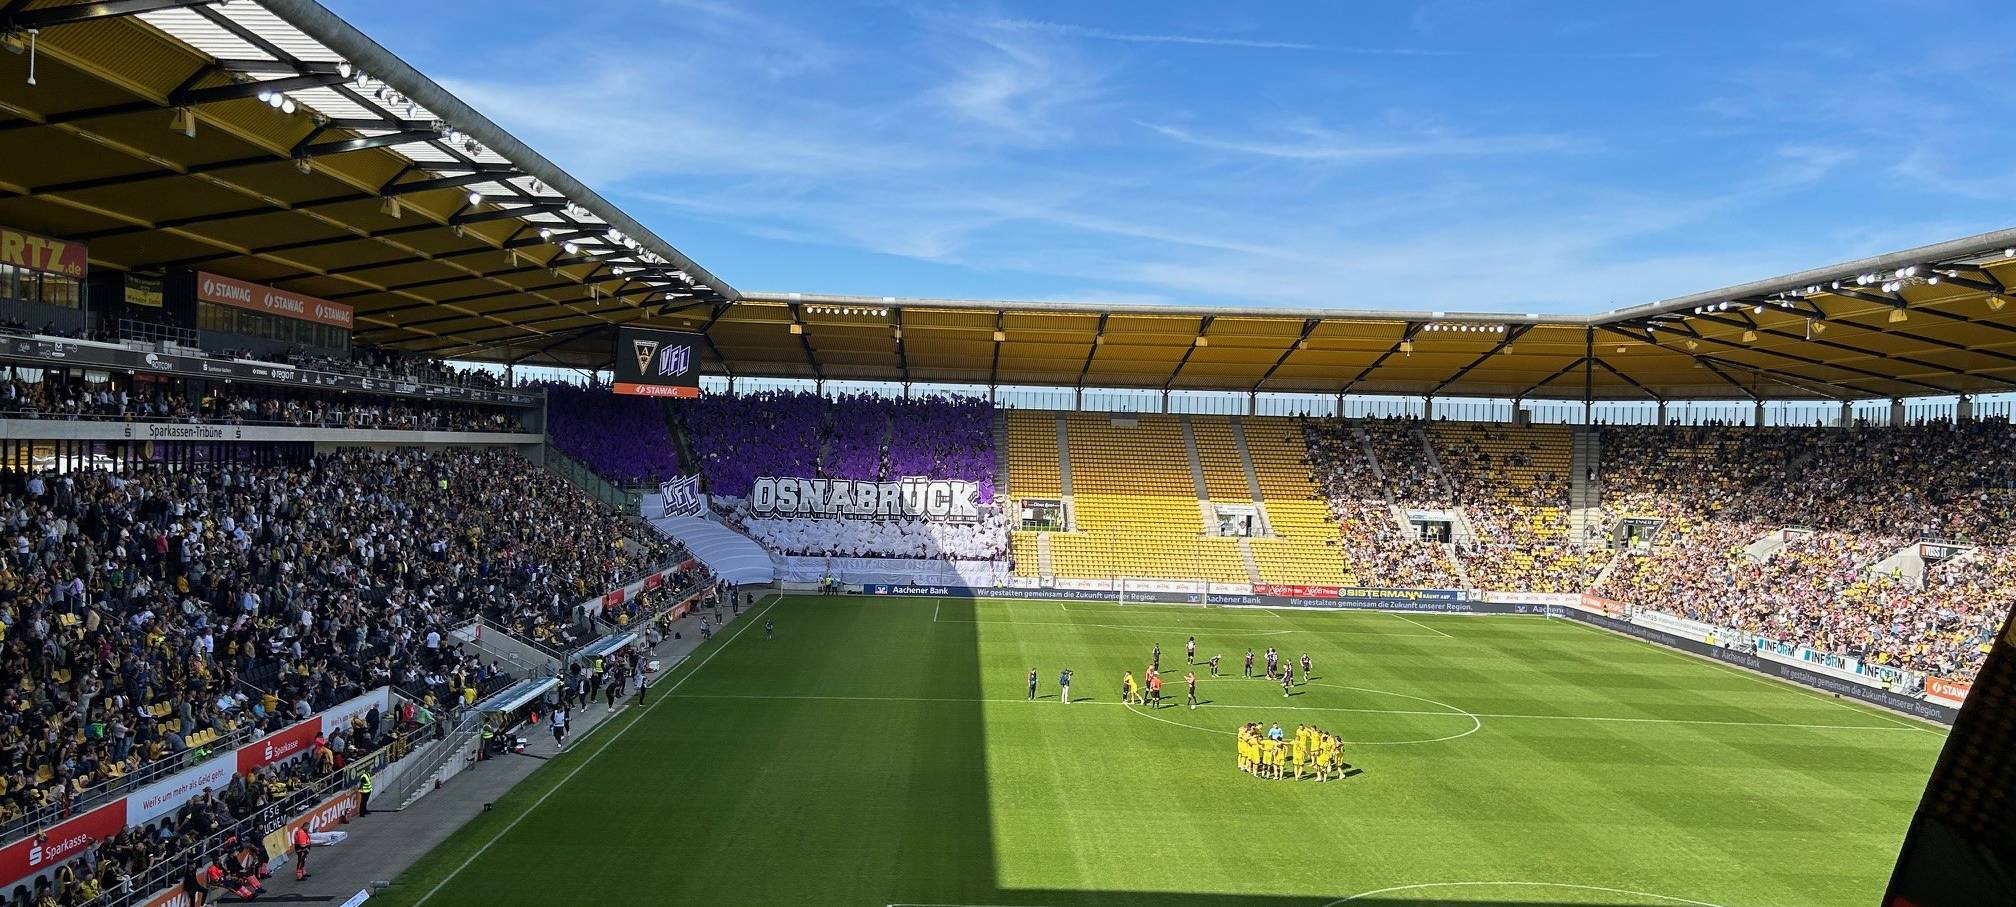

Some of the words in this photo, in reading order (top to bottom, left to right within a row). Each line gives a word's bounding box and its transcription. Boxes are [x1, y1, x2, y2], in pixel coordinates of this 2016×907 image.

[216, 283, 251, 303] STAWAG
[274, 295, 304, 313] STAWAG
[324, 307, 350, 323] STAWAG
[645, 386, 678, 395] STAWAG
[149, 424, 223, 439] Sparkassen-Tribüne
[753, 477, 978, 521] OSNABRÜCK
[892, 586, 928, 595] Aachener
[929, 586, 949, 596] Bank
[977, 588, 990, 596] Wir
[990, 589, 1023, 598] gestalten
[1024, 590, 1062, 599] gemeinsam
[1063, 590, 1074, 598] die
[1075, 591, 1103, 599] Zukunft
[1243, 594, 1261, 604] Bank
[1347, 589, 1423, 599] SISTERMANN
[1290, 598, 1303, 606] Wir
[1303, 599, 1337, 608] gestalten
[1338, 601, 1377, 609] gemeinsam
[1378, 601, 1389, 609] die
[1389, 601, 1418, 609] Zukunft
[1419, 602, 1446, 610] unserer
[1446, 603, 1473, 611] Region.
[1764, 640, 1795, 657] INFORM
[1722, 650, 1746, 665] Aachener
[1747, 655, 1761, 669] Bank
[1811, 652, 1846, 670] INFORM
[1780, 666, 1790, 676] Wir
[1790, 668, 1817, 685] gestalten
[1817, 677, 1850, 692] gemeinsam
[1851, 683, 1861, 696] die
[1861, 687, 1887, 704] Zukunft
[1888, 696, 1915, 711] unserer
[1915, 702, 1942, 718] Region.
[274, 740, 299, 758] Sparkasse
[143, 796, 161, 810] Weil's
[162, 790, 173, 802] um
[172, 784, 189, 799] mehr
[189, 780, 198, 791] als
[197, 774, 211, 786] Geld
[321, 794, 358, 828] STAWAG
[263, 814, 288, 836] UCHEN
[45, 833, 87, 860] Sparkasse
